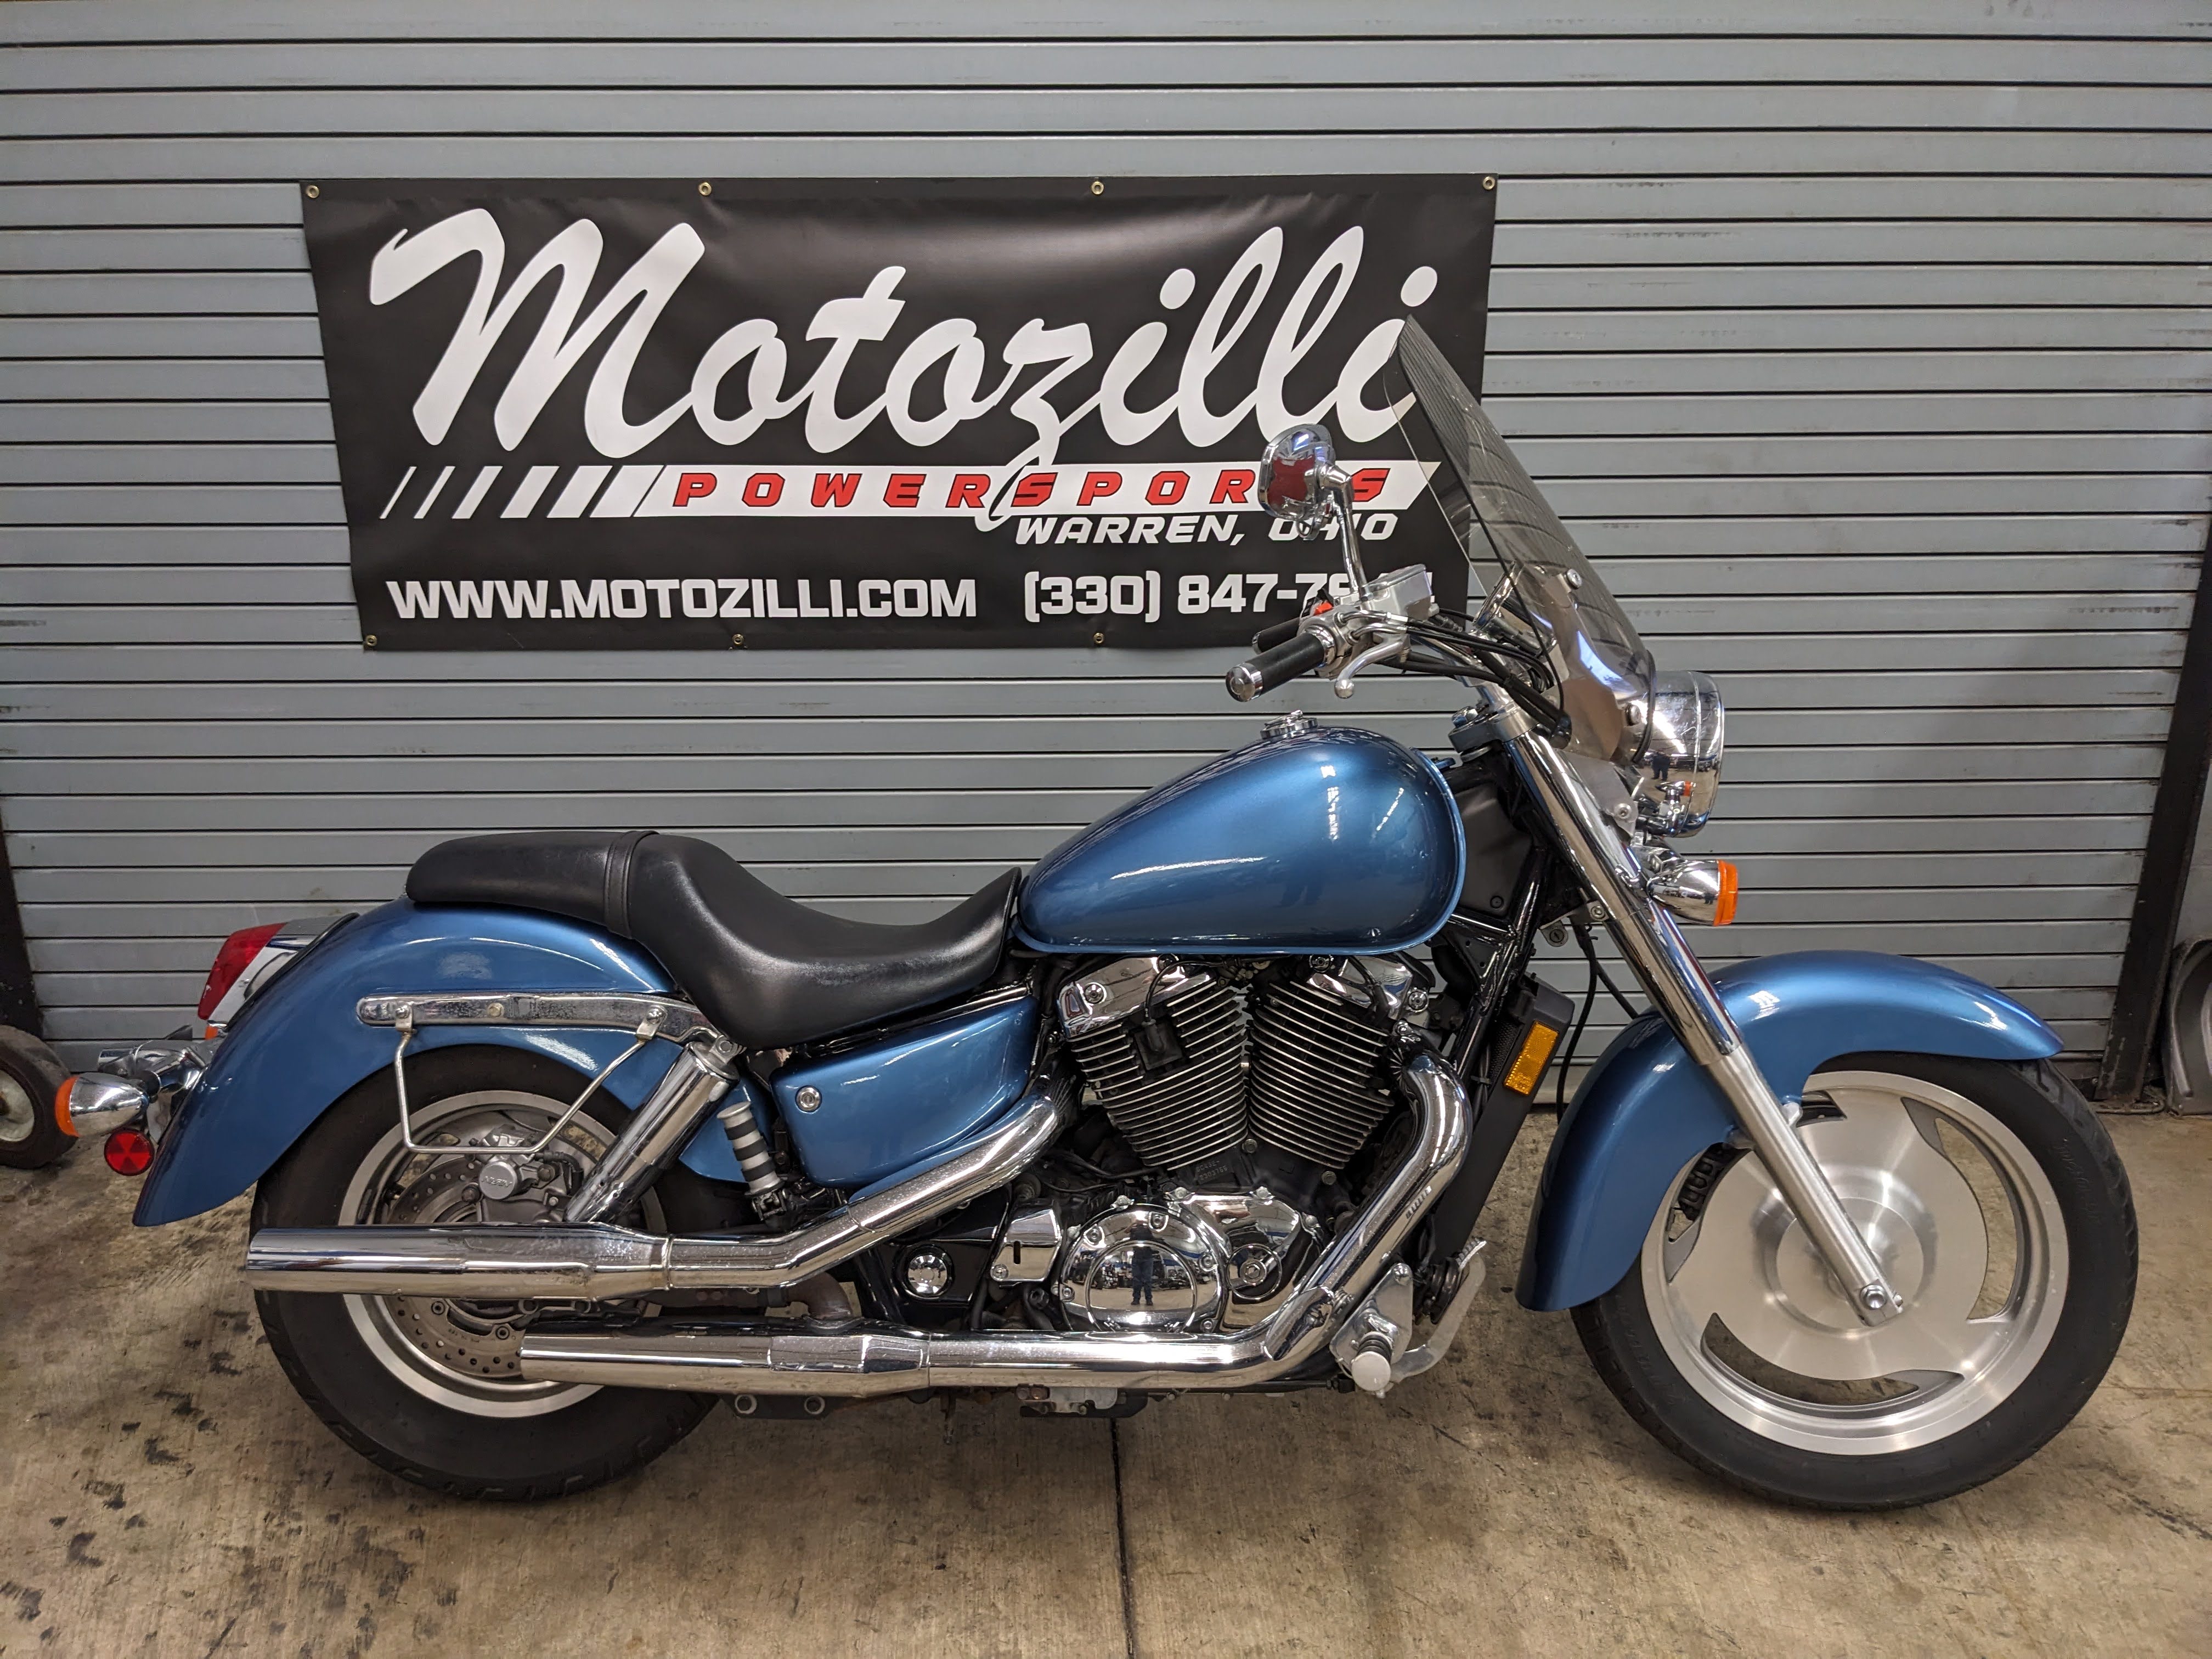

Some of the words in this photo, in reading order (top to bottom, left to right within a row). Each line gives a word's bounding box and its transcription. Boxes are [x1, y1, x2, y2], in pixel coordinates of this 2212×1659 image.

[370, 208, 1438, 532] Motozilli
[672, 468, 1391, 508] POWERSPORS
[1015, 514, 1245, 546] WARREN,
[386, 578, 977, 619] WWW.MOTOZILLI.COM
[1024, 571, 1161, 623] (330)
